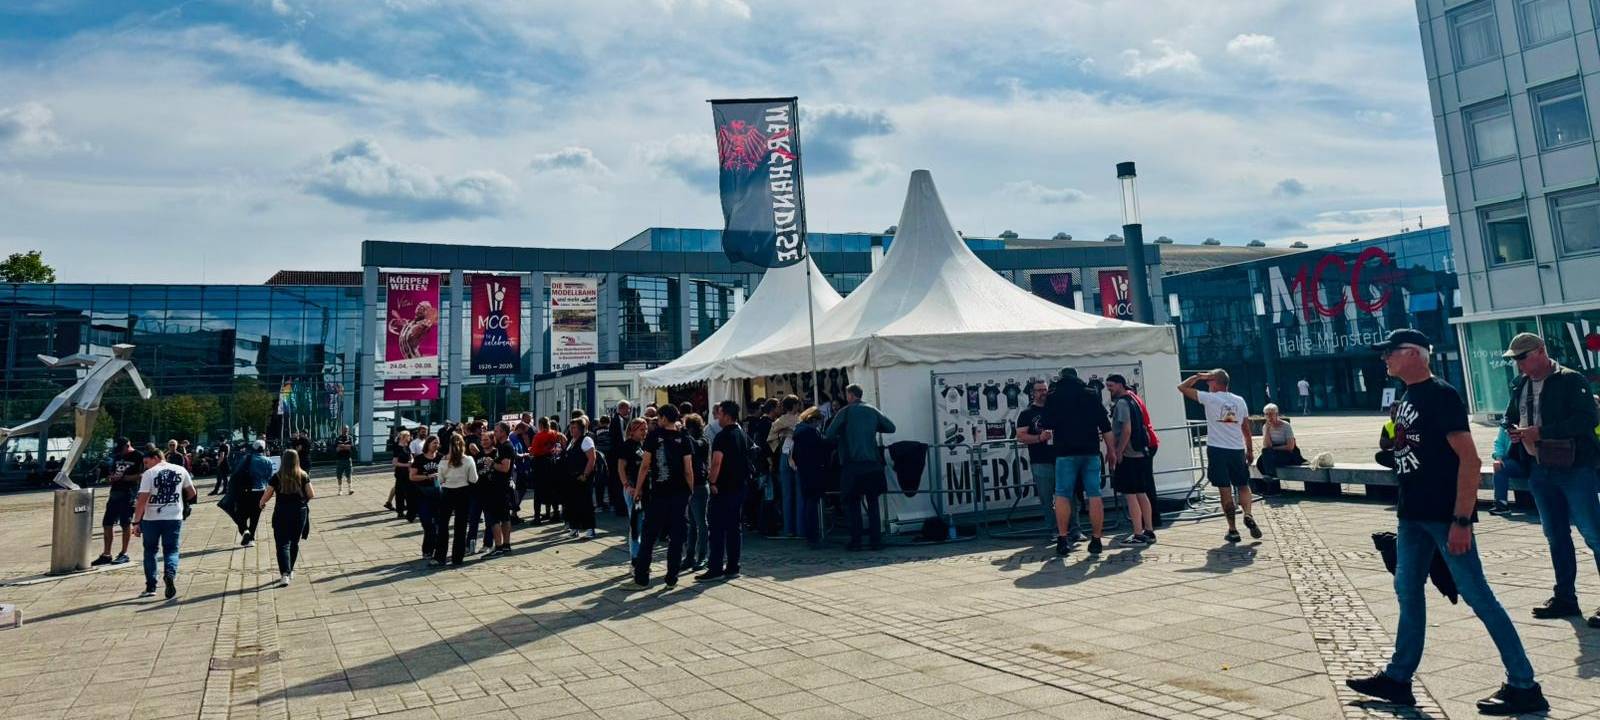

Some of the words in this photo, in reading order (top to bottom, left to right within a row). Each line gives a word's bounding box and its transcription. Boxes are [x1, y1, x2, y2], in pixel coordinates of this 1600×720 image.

[389, 275, 429, 285] KÖRPER
[390, 283, 428, 291] WELTEN
[1277, 334, 1312, 353] Halle
